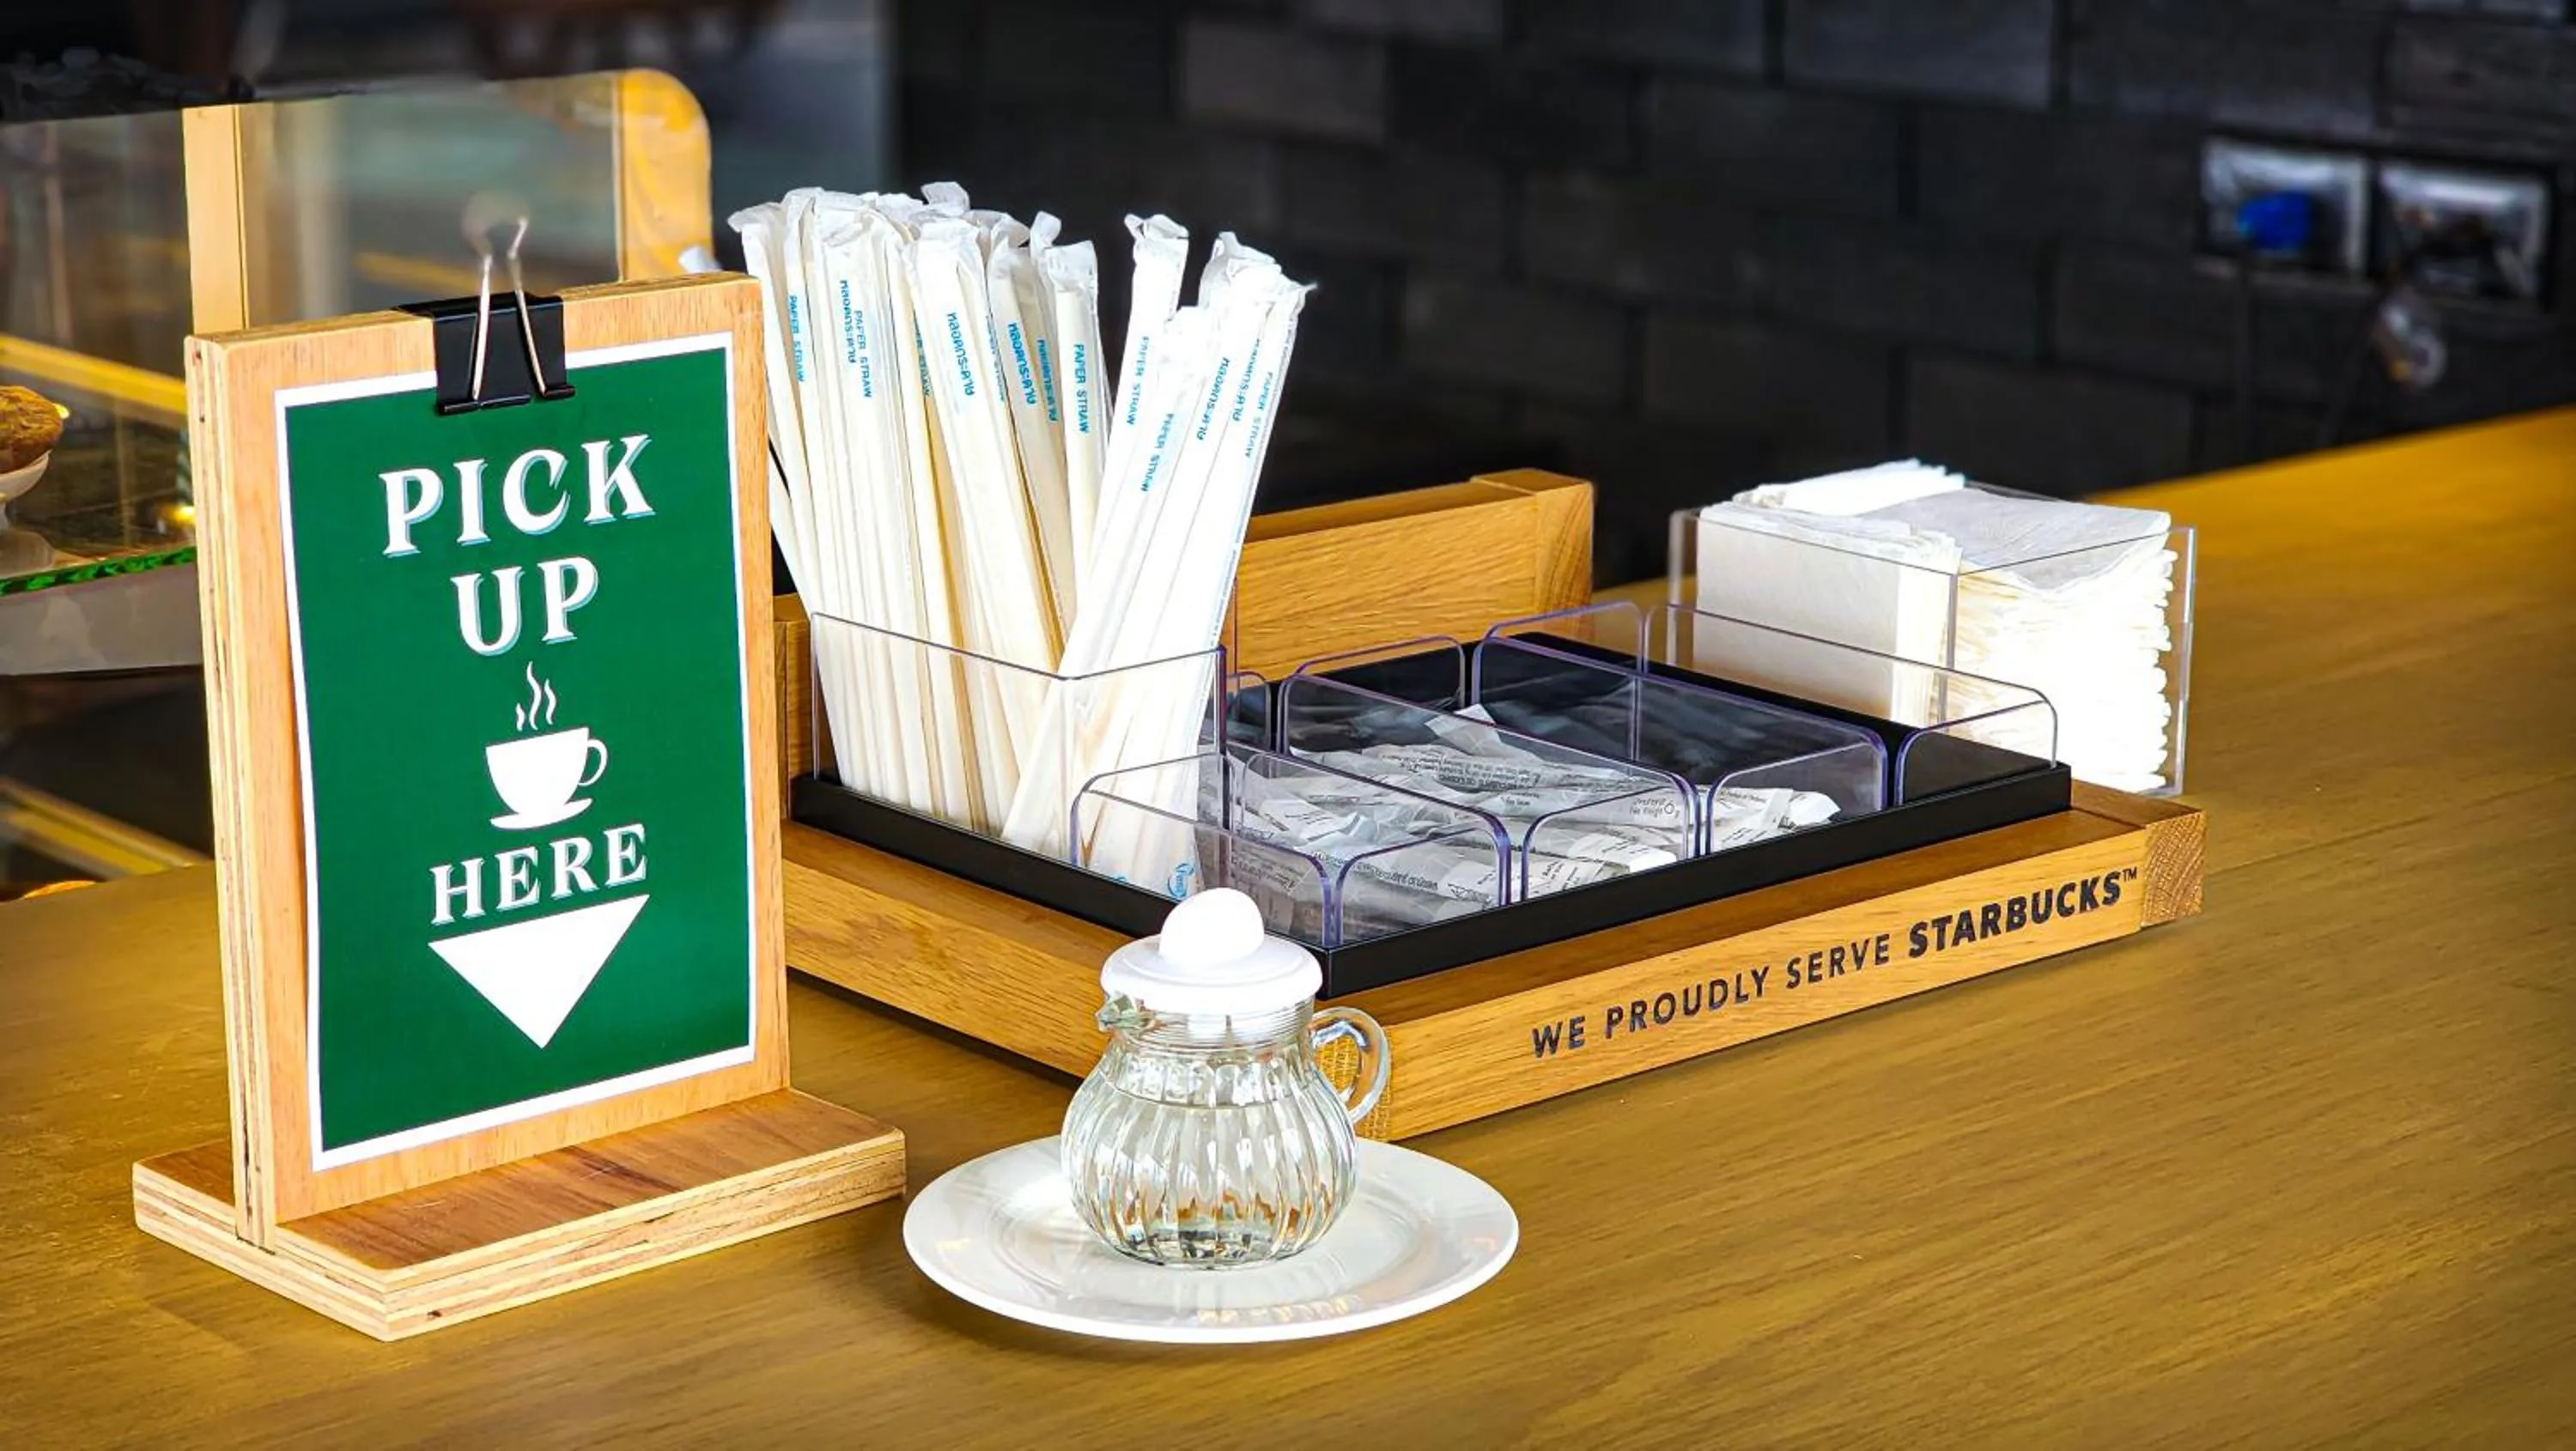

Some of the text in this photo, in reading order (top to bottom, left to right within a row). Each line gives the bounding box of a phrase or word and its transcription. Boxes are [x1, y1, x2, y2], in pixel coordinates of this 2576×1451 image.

[854, 310, 872, 398] PAPER STRAW
[946, 312, 975, 396] หลอดกระดาษ
[1007, 322, 1037, 405] หลอดกระดาษ
[1073, 344, 1091, 434] PAPER STRAW
[379, 434, 657, 558] PICK
[450, 556, 599, 657] UP
[429, 822, 650, 926] HERE
[1531, 1016, 1586, 1058] WE
[1604, 966, 1770, 1040] PROUDLY
[1785, 933, 1889, 989] SERVE
